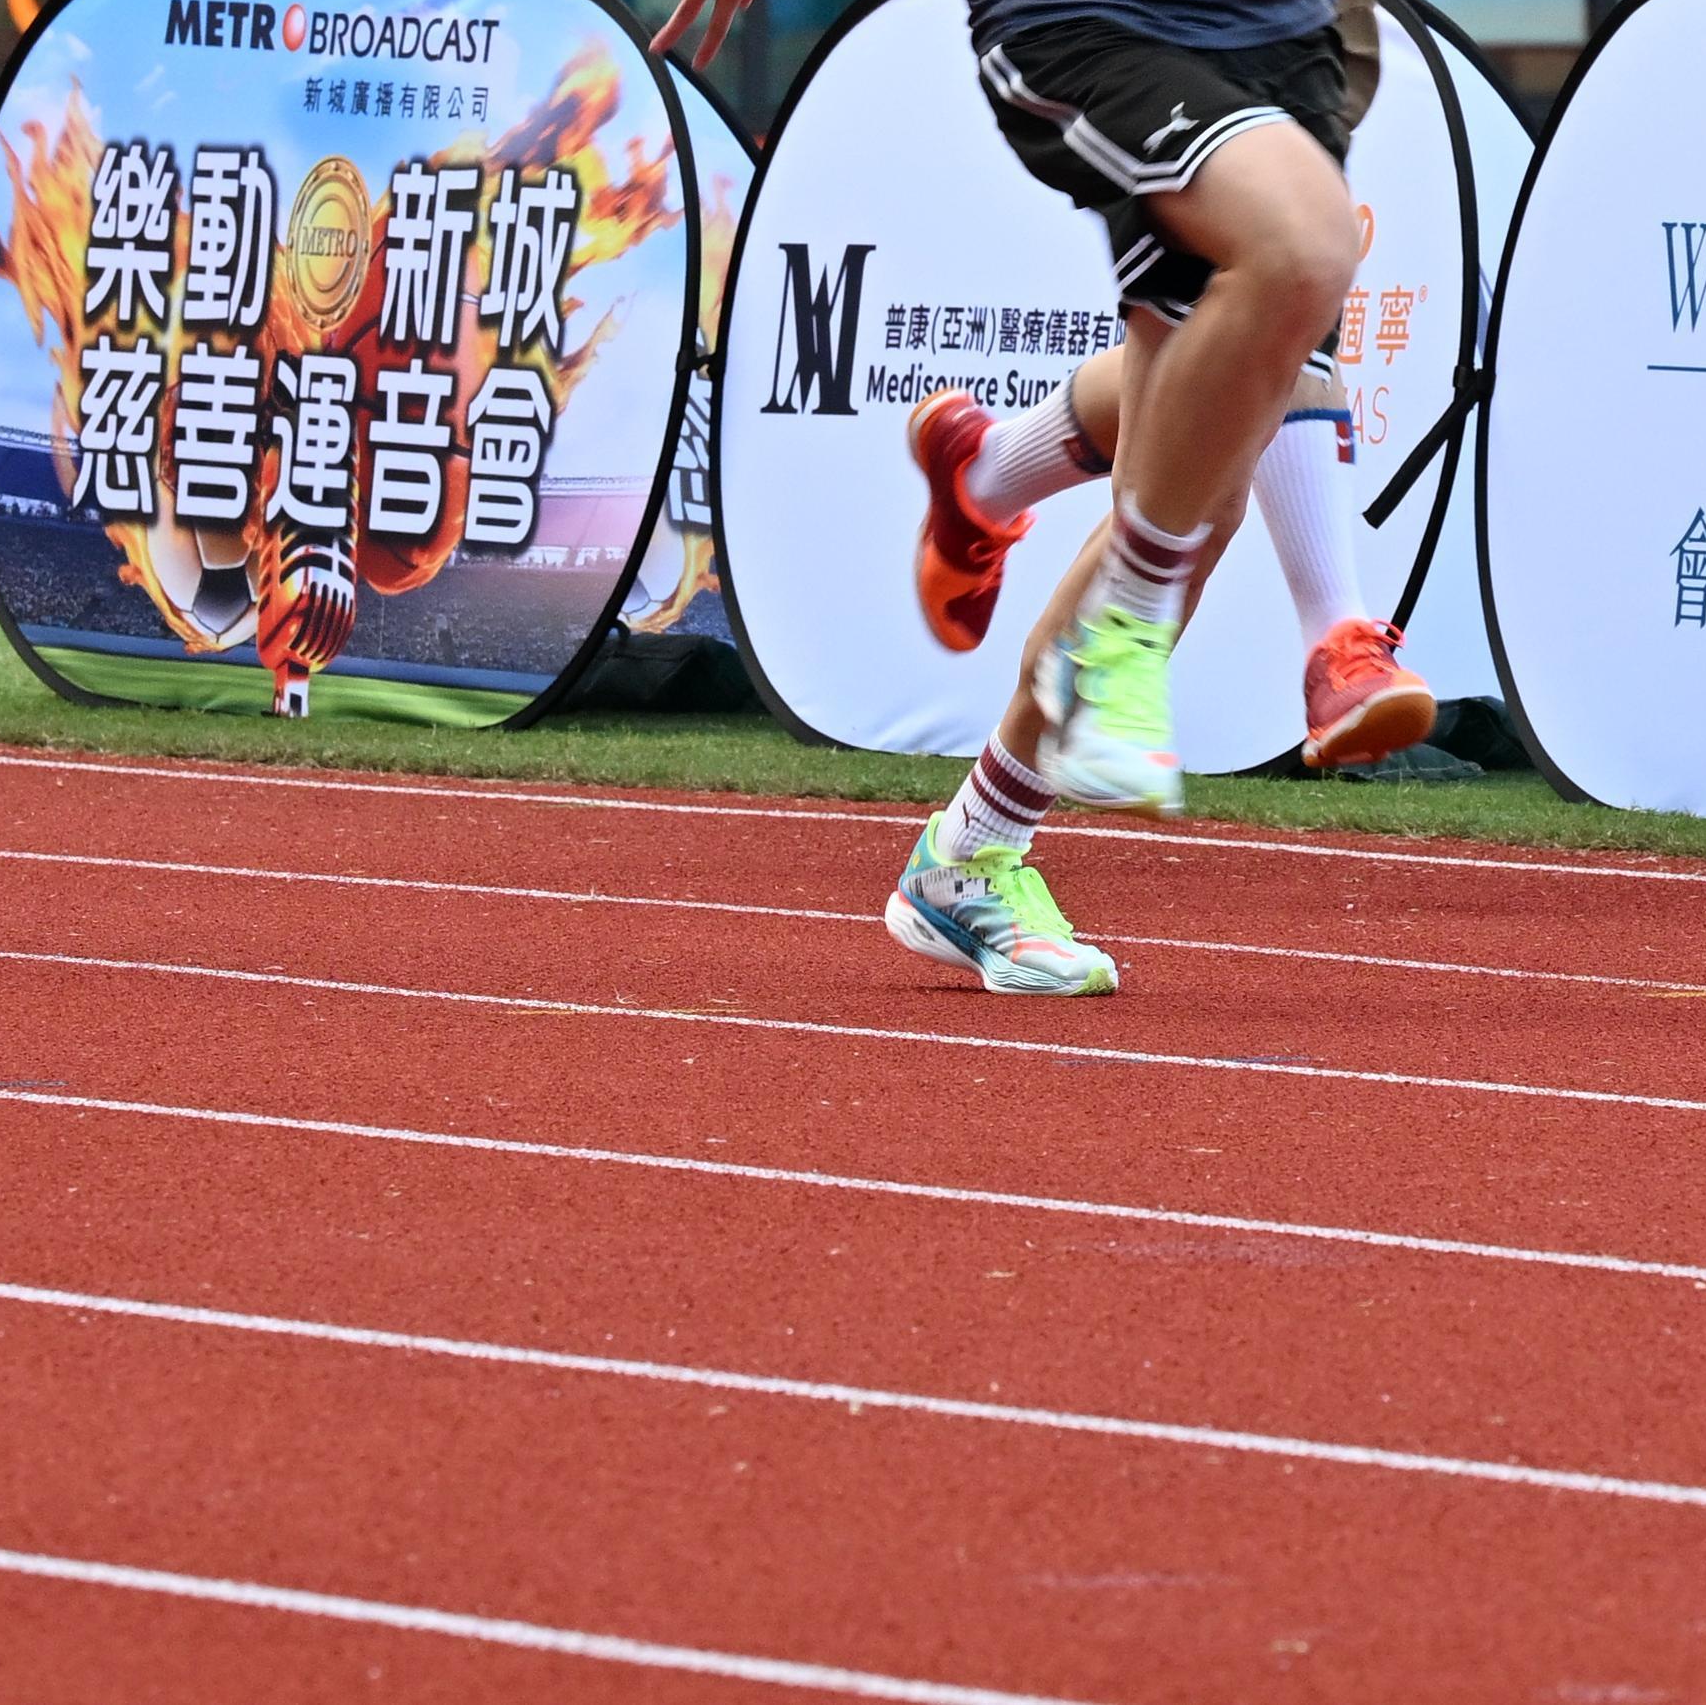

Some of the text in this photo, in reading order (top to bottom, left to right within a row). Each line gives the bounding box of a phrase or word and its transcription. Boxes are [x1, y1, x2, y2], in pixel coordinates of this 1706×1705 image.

[303, 77, 490, 123] 新城廣播有限公司
[84, 144, 577, 350] 樂動 新城
[300, 226, 357, 258] METRO
[71, 337, 553, 545] 慈善運音會
[1344, 386, 1390, 445] AS
